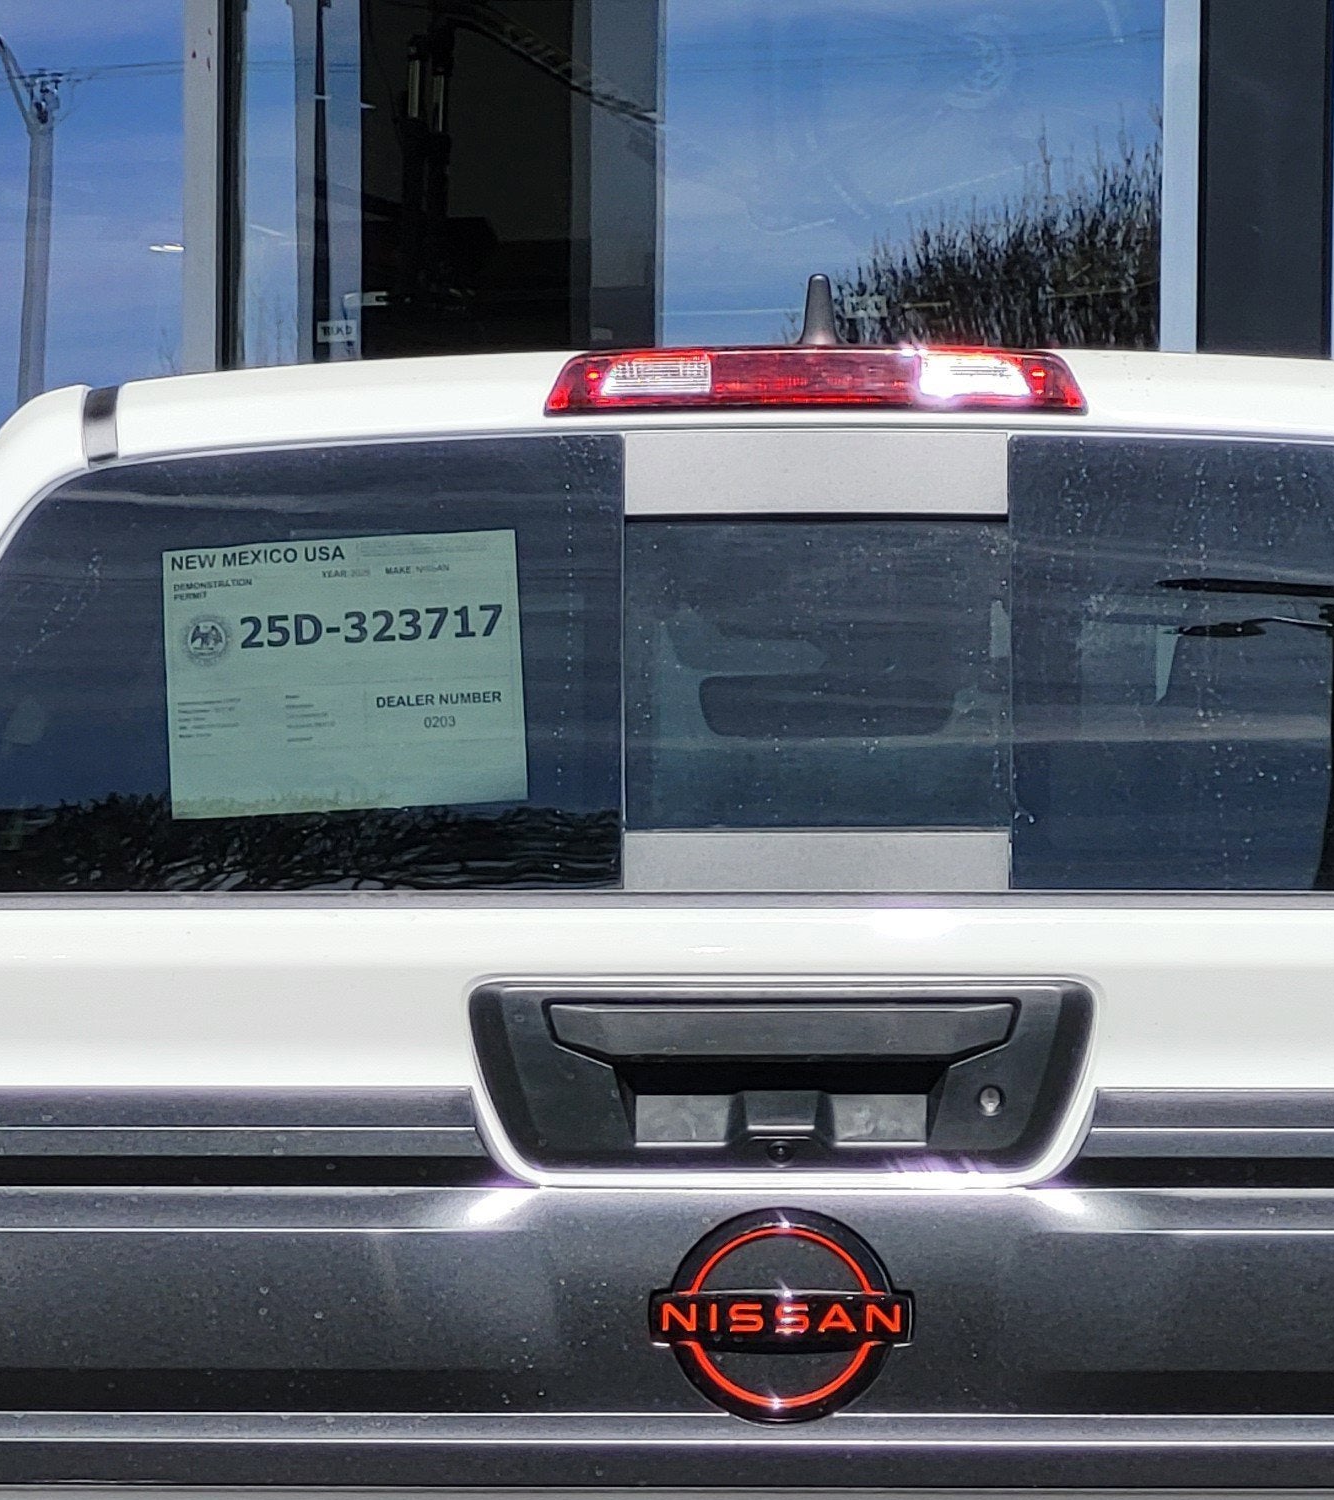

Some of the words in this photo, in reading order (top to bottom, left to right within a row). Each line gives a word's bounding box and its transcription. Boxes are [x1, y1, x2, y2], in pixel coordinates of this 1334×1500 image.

[171, 554, 216, 571] NEW
[222, 548, 297, 568] MEXICO
[304, 545, 345, 562] USA
[322, 570, 347, 579] YEAR
[385, 565, 412, 575] MAKE
[174, 578, 252, 591] DEMONSTRATION
[174, 591, 207, 601] PERMIT
[240, 604, 503, 649] 25D-323717
[376, 694, 435, 708] DEALER
[439, 691, 502, 705] NUMBER
[424, 716, 456, 728] 0203
[662, 1303, 901, 1332] NISSAN
